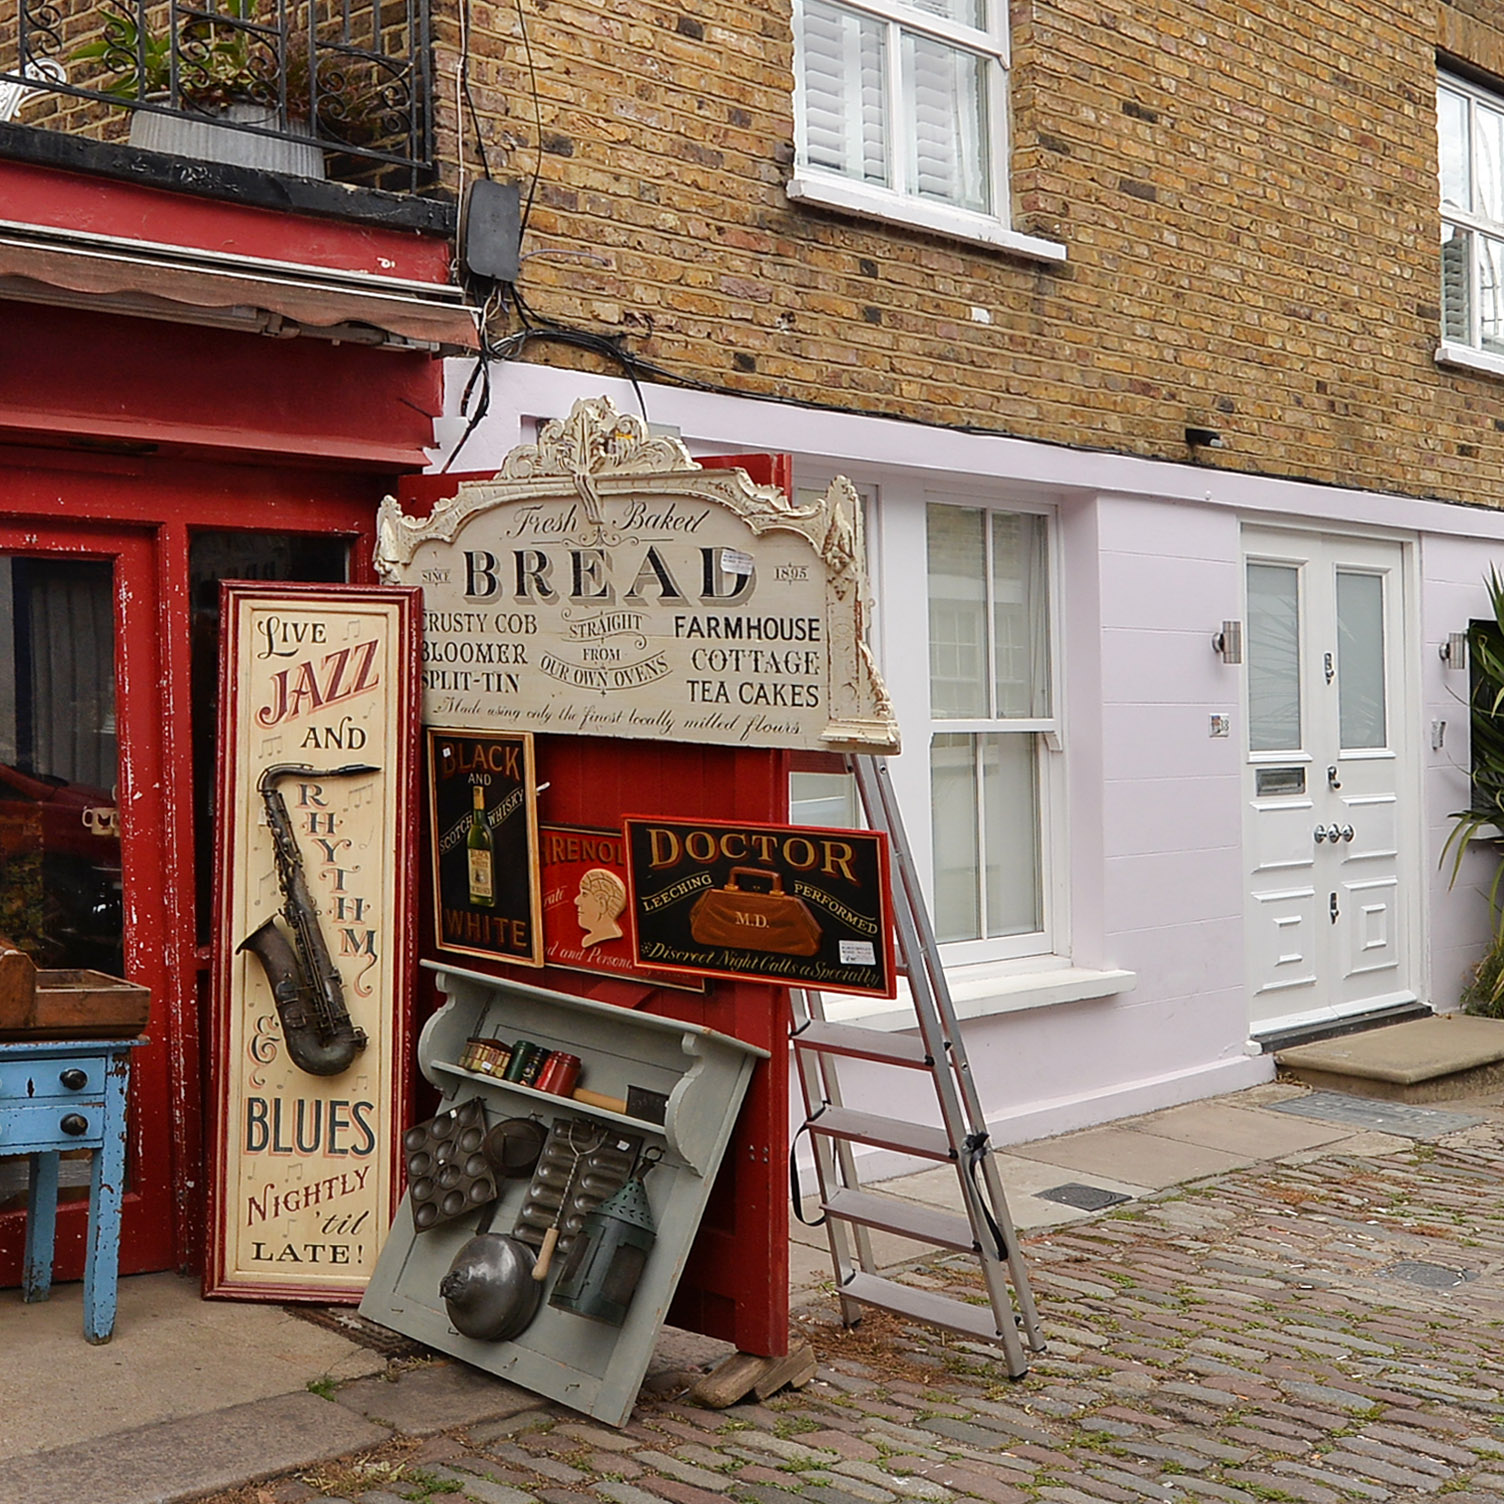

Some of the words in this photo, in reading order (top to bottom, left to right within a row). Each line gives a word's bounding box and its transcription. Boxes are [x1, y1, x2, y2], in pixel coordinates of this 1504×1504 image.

[506, 504, 578, 538] Fresh
[612, 498, 711, 534] Baked
[463, 545, 757, 606] BREAD
[775, 567, 808, 579] 1895
[495, 613, 537, 634] COB
[569, 614, 643, 639] STRAIGHT
[674, 616, 821, 642] FARMHOUSE
[422, 641, 528, 664] BLOOMER
[583, 648, 621, 662] FROM
[691, 648, 821, 675] COTTAGE
[255, 639, 380, 729] JAZZ
[422, 669, 520, 693] SPLIT-TIN
[540, 655, 570, 681] OUR
[574, 671, 608, 688] OWN
[614, 654, 670, 687] OVENS
[686, 679, 731, 704] TEA
[739, 681, 821, 708] CAKES
[432, 696, 481, 715] Made
[487, 703, 522, 721] using
[526, 703, 553, 722] only
[558, 704, 577, 721] the
[580, 705, 623, 729] finest
[627, 708, 675, 735] locally
[683, 710, 742, 732] milled
[300, 716, 367, 750] AND
[442, 742, 521, 781] BLACK
[467, 772, 493, 787] AND
[439, 813, 474, 854] SCOTCH
[487, 788, 526, 829] WHISKY
[648, 827, 860, 885] DOCTOR
[296, 783, 378, 998] RHYTHM
[642, 873, 714, 913] LEECHING
[793, 882, 880, 937] PERFORMED
[445, 908, 528, 949] WHITE
[734, 911, 771, 929] M.D.
[560, 945, 587, 962] and
[649, 941, 715, 966] Discreet
[717, 950, 760, 973] Night
[760, 955, 799, 976] Calls
[243, 1097, 376, 1160] BLUES
[251, 1241, 363, 1265] LATE!
